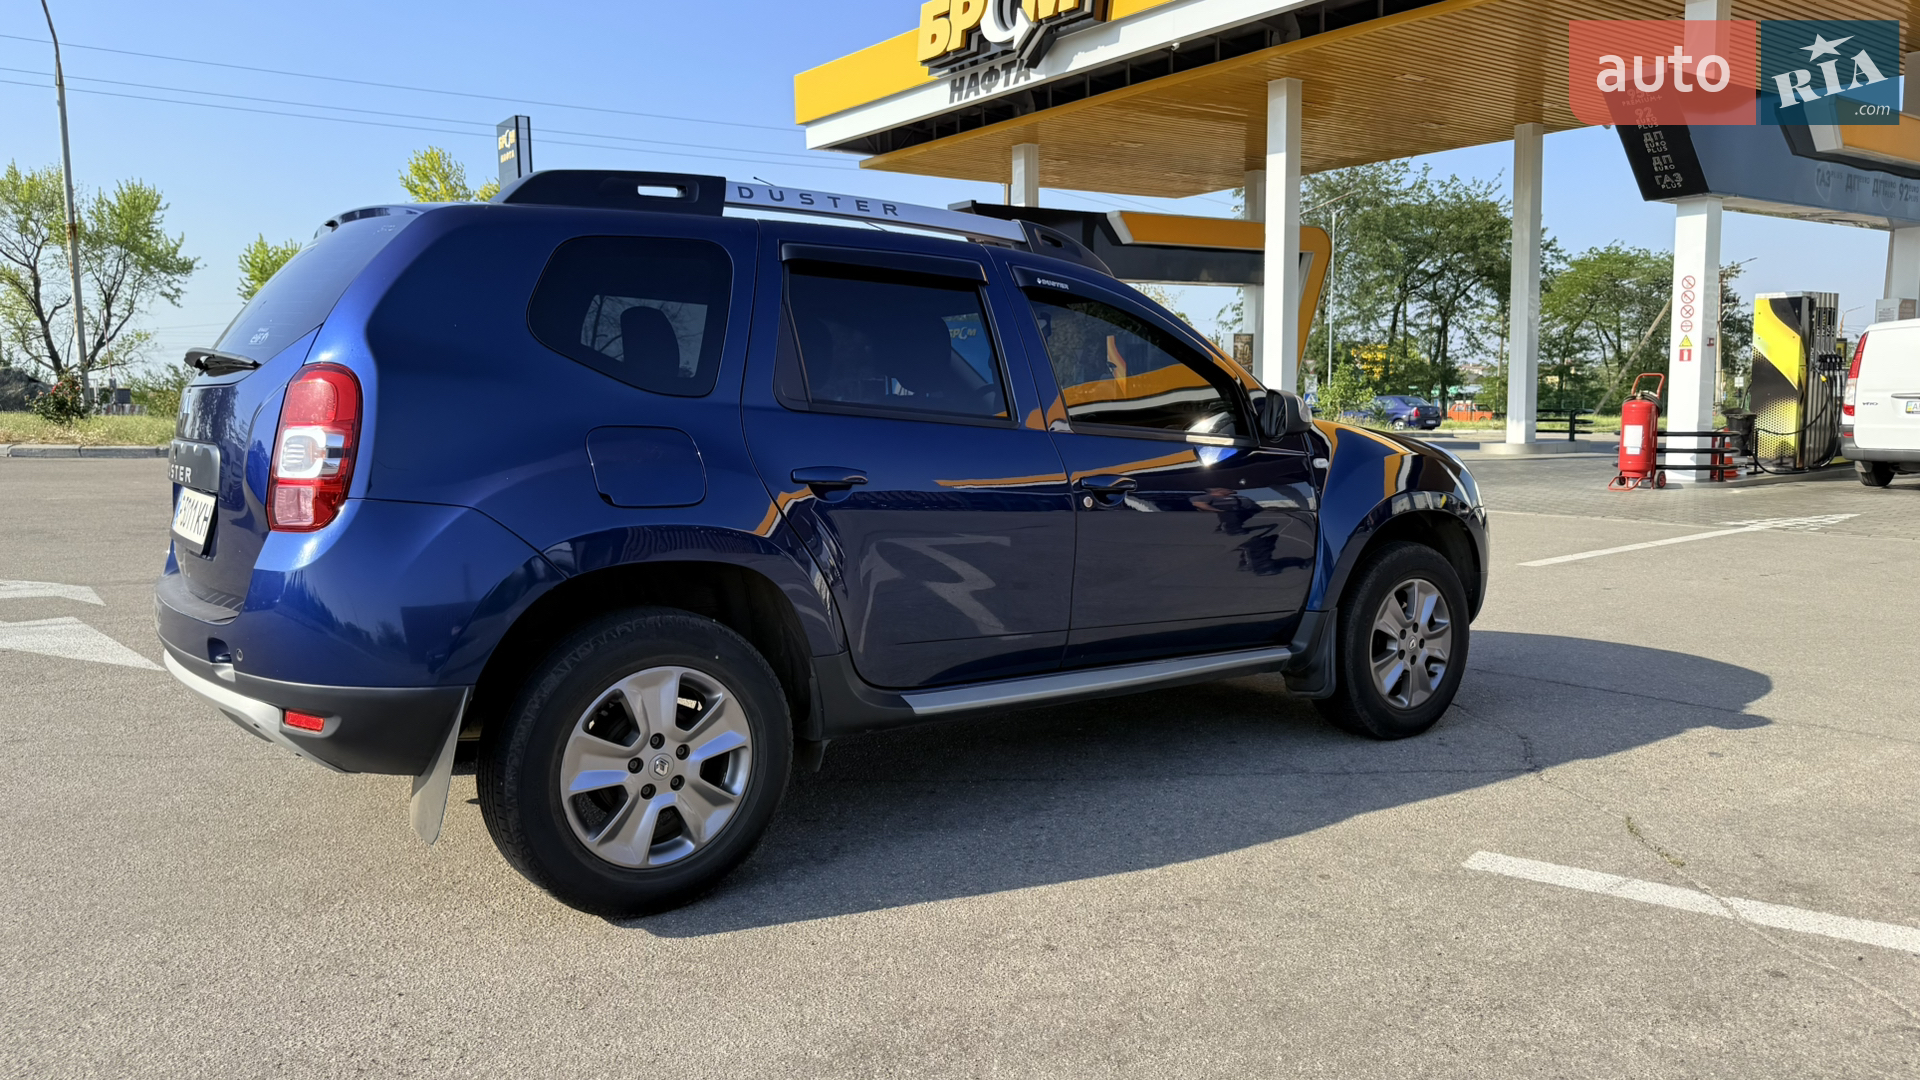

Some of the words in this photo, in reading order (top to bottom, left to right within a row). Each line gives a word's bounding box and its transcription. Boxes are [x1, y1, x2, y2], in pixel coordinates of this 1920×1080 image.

[949, 59, 1031, 104] НАФТА
[1634, 106, 1654, 120] 92
[1635, 116, 1658, 126] EURO
[1646, 146, 1668, 154] PLUS
[1653, 164, 1676, 172] EURO
[1654, 172, 1683, 186] ГАЗ
[1661, 182, 1683, 190] PLUS
[737, 186, 899, 217] DUSTER
[168, 463, 191, 484] STER
